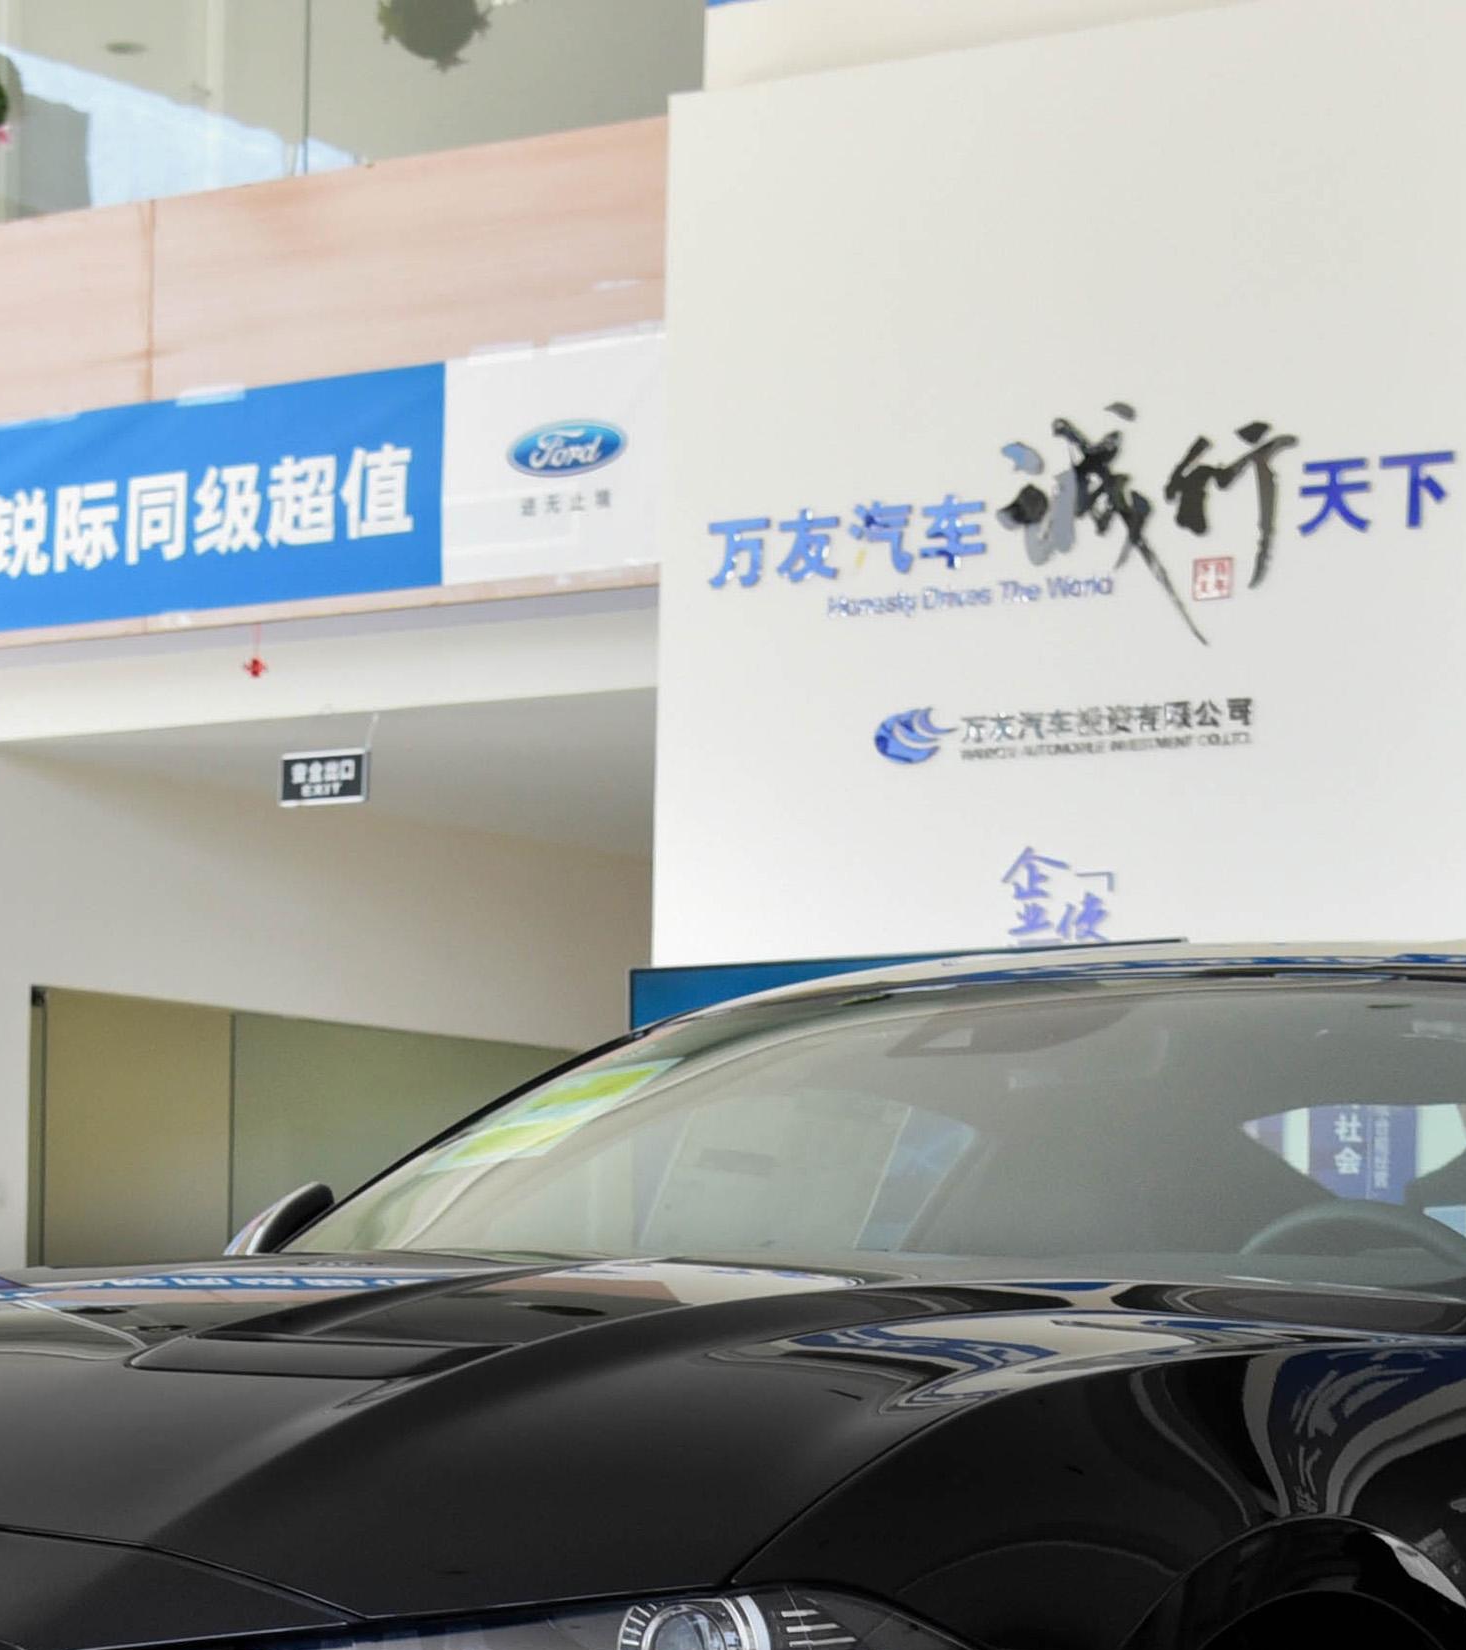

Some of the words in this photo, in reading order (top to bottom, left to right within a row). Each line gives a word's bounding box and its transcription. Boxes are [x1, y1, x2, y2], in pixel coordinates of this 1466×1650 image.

[527, 427, 605, 471] Ford
[998, 580, 1043, 602] The
[1332, 1104, 1364, 1176] 社会
